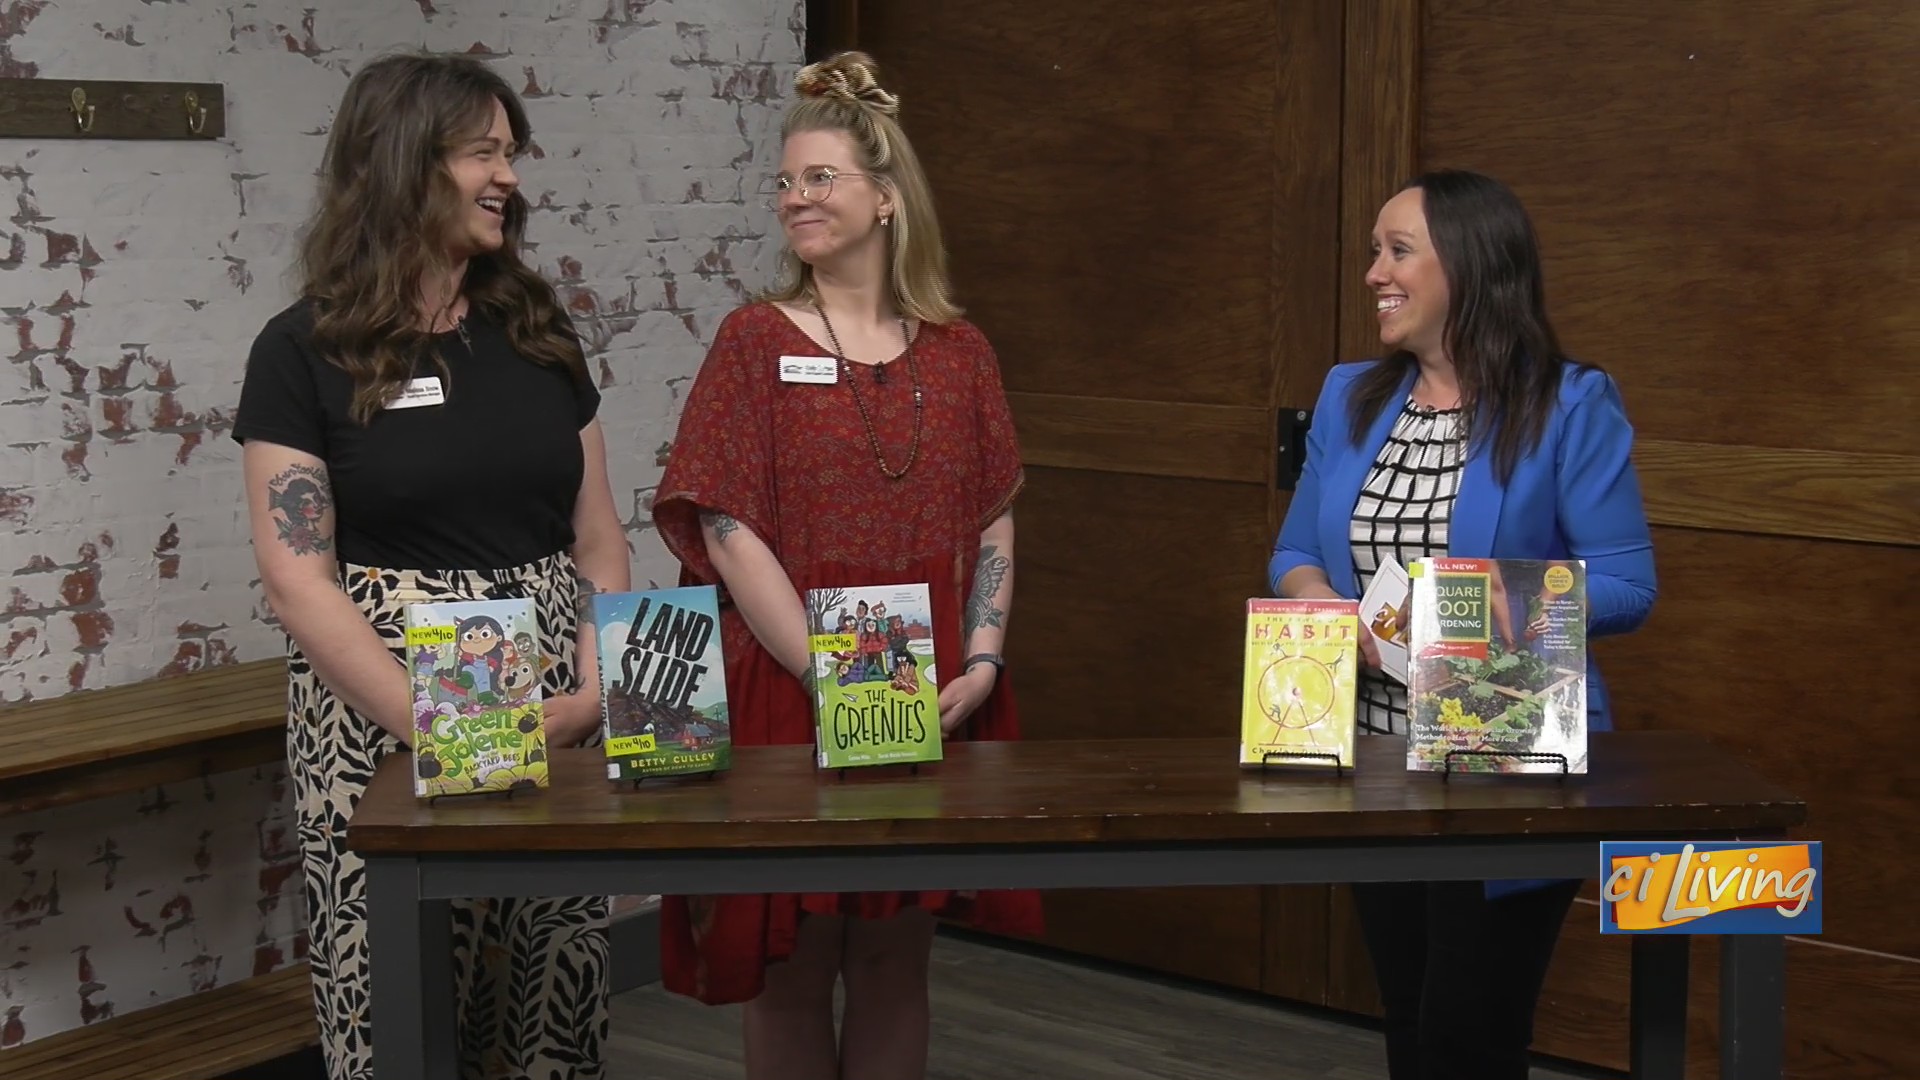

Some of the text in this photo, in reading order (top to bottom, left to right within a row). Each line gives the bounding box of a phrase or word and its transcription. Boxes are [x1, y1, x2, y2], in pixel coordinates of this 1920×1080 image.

[1436, 586, 1482, 598] QUARE
[1437, 600, 1482, 617] OOT
[625, 597, 715, 662] LAND
[1255, 623, 1351, 640] HABIT
[1440, 619, 1482, 628] RDENING
[412, 631, 432, 639] NEW
[612, 646, 709, 712] SLIDE
[865, 689, 887, 703] THE
[431, 708, 512, 745] Green
[834, 697, 926, 750] GREENIES
[437, 730, 523, 778] Jolene
[613, 742, 632, 750] NEW
[464, 755, 501, 775] BACKYARD
[503, 752, 521, 762] BEES
[631, 752, 715, 768] BETTY CULLEY
